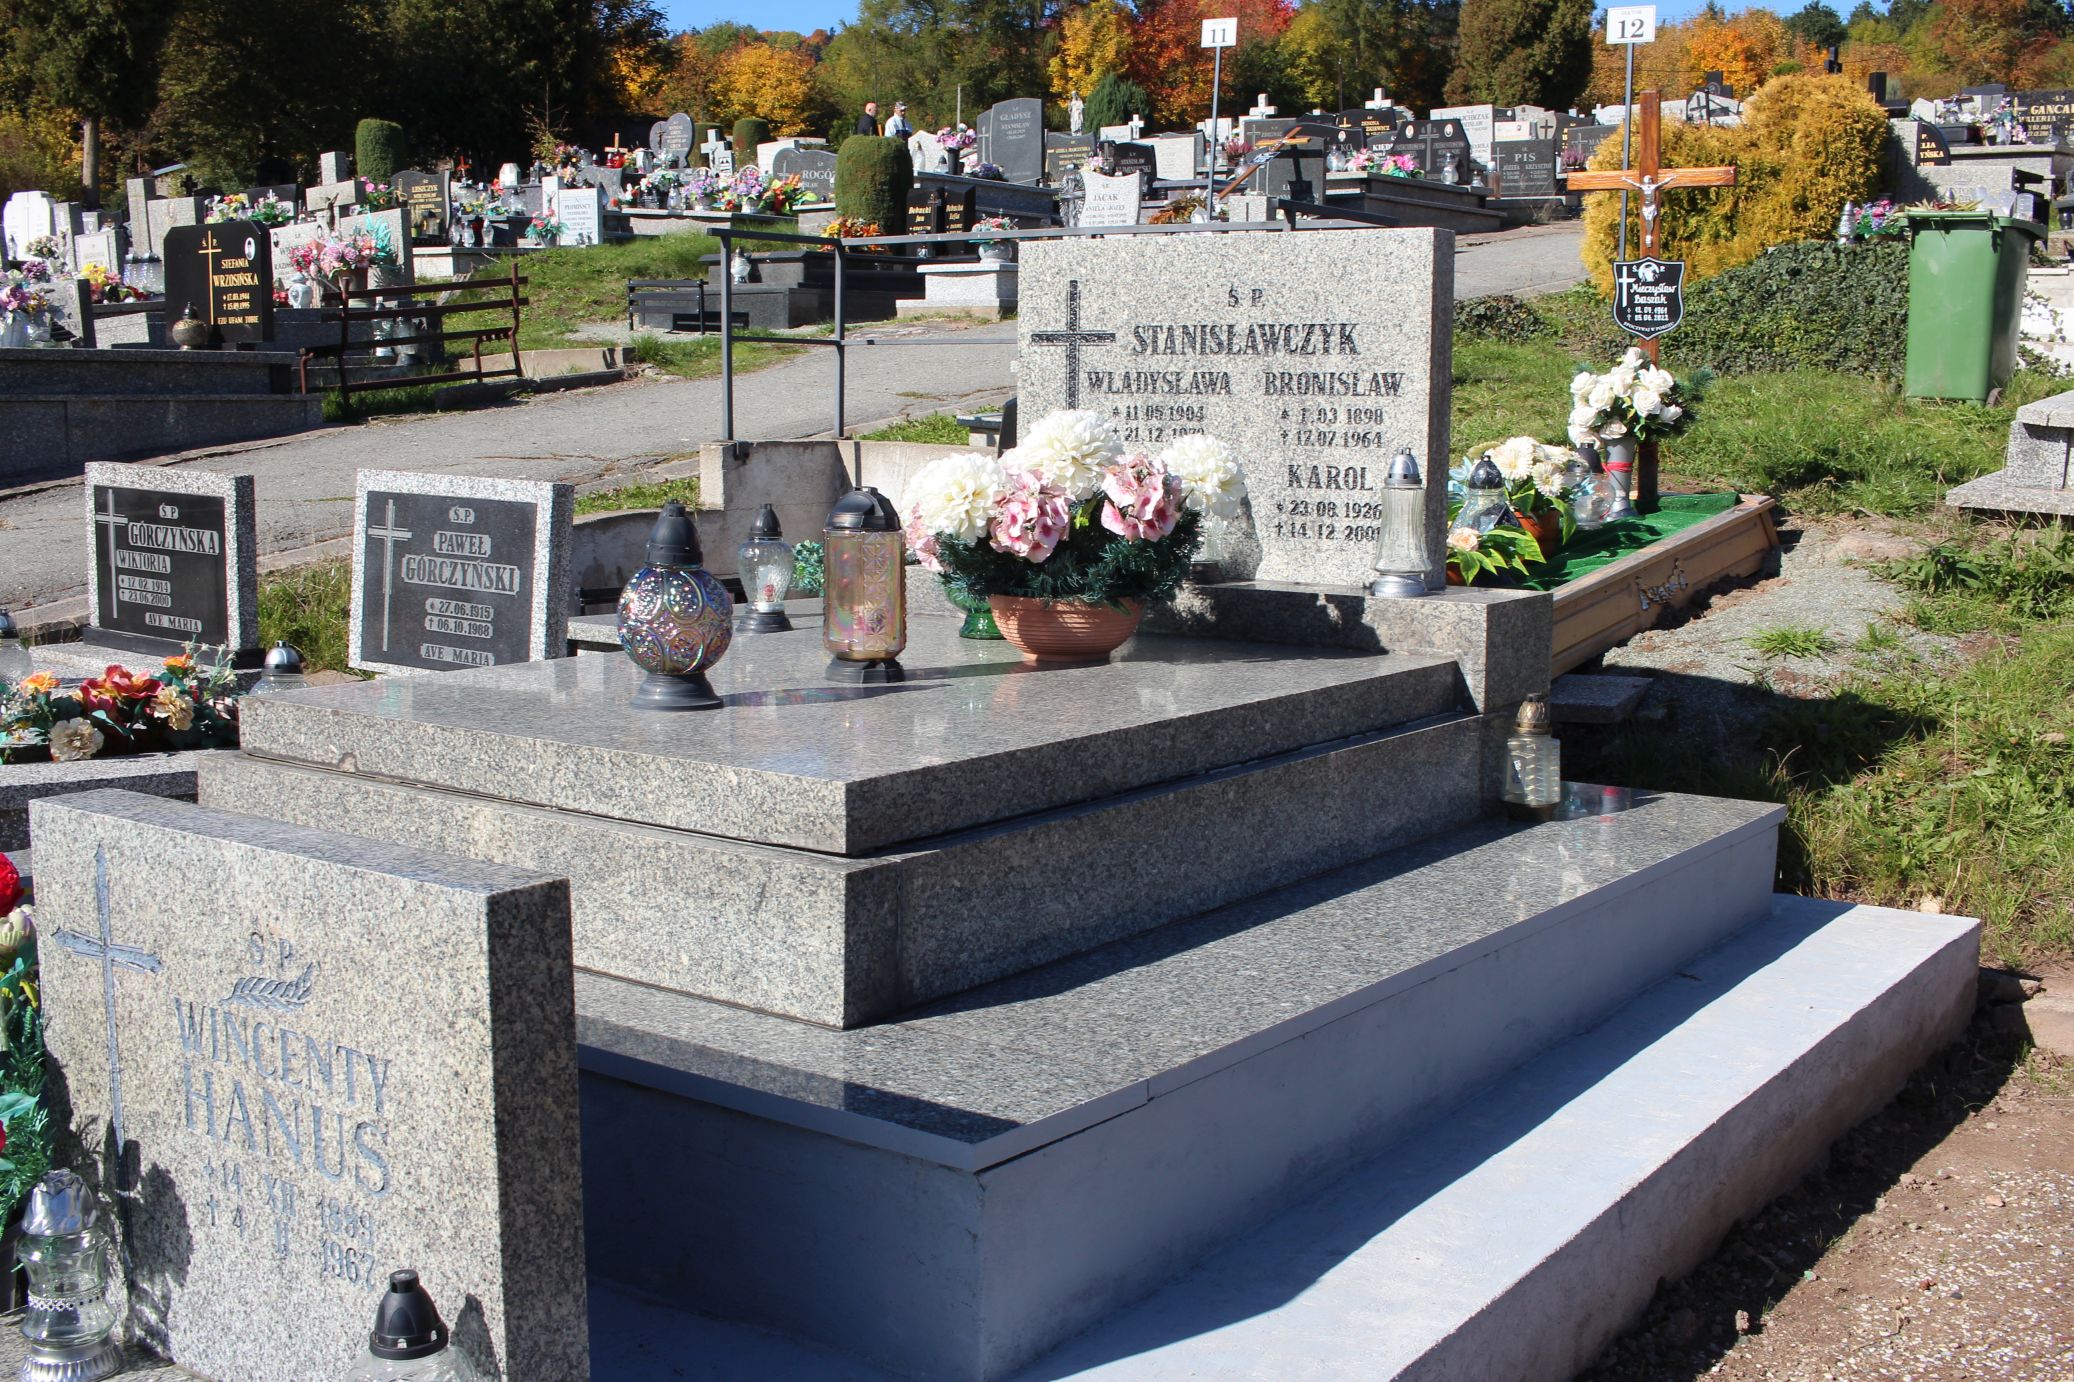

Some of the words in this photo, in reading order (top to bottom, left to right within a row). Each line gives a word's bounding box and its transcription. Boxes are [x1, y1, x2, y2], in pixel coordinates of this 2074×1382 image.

[1210, 28, 1228, 43] 11
[1617, 19, 1645, 39] 12
[1514, 153, 1536, 162] PIS
[221, 258, 249, 268] STEFANIA
[213, 272, 259, 287] WRZOSIŃSKA
[1630, 282, 1677, 296] Mieczysław
[1133, 322, 1361, 357] STANISŁAWCZYK
[1087, 370, 1232, 397] WŁADYSŁAWA
[1263, 371, 1406, 397] BRONISŁAW
[1288, 464, 1374, 491] KAROL
[130, 520, 219, 555] GÓRCZYŃSKA
[439, 532, 487, 556] PAWEŁ
[118, 550, 168, 572] WIKTORIA
[406, 554, 516, 593] GÓRCZYŃSKI
[439, 600, 491, 620] 27.06.1915
[148, 614, 164, 625] AVE
[168, 616, 199, 632] MARIA
[424, 645, 444, 659] AVE
[453, 649, 490, 666] MARIA
[175, 997, 392, 1115] WINCENTY
[183, 1063, 392, 1198] HANUS
[321, 1238, 375, 1291] 1967
